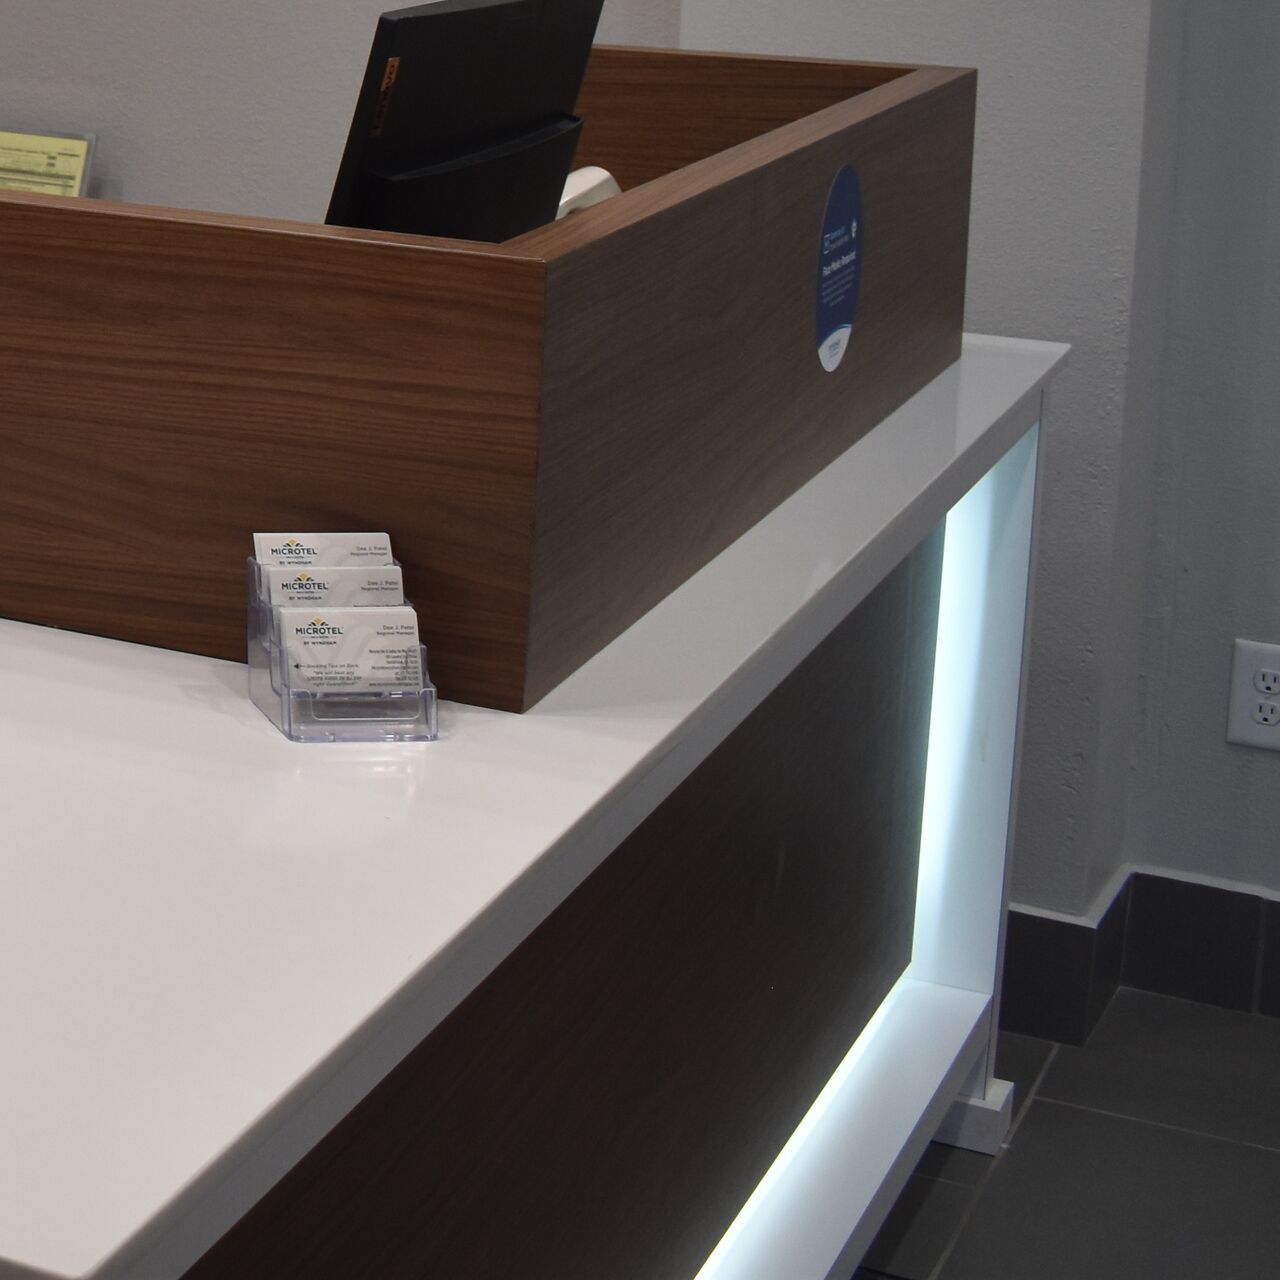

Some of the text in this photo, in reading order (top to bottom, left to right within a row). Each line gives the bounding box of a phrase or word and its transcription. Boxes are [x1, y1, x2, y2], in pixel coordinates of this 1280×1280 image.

[271, 548, 317, 556] MICROTEL
[281, 582, 328, 590] MICROTEL
[295, 627, 343, 635] MICROTEL
